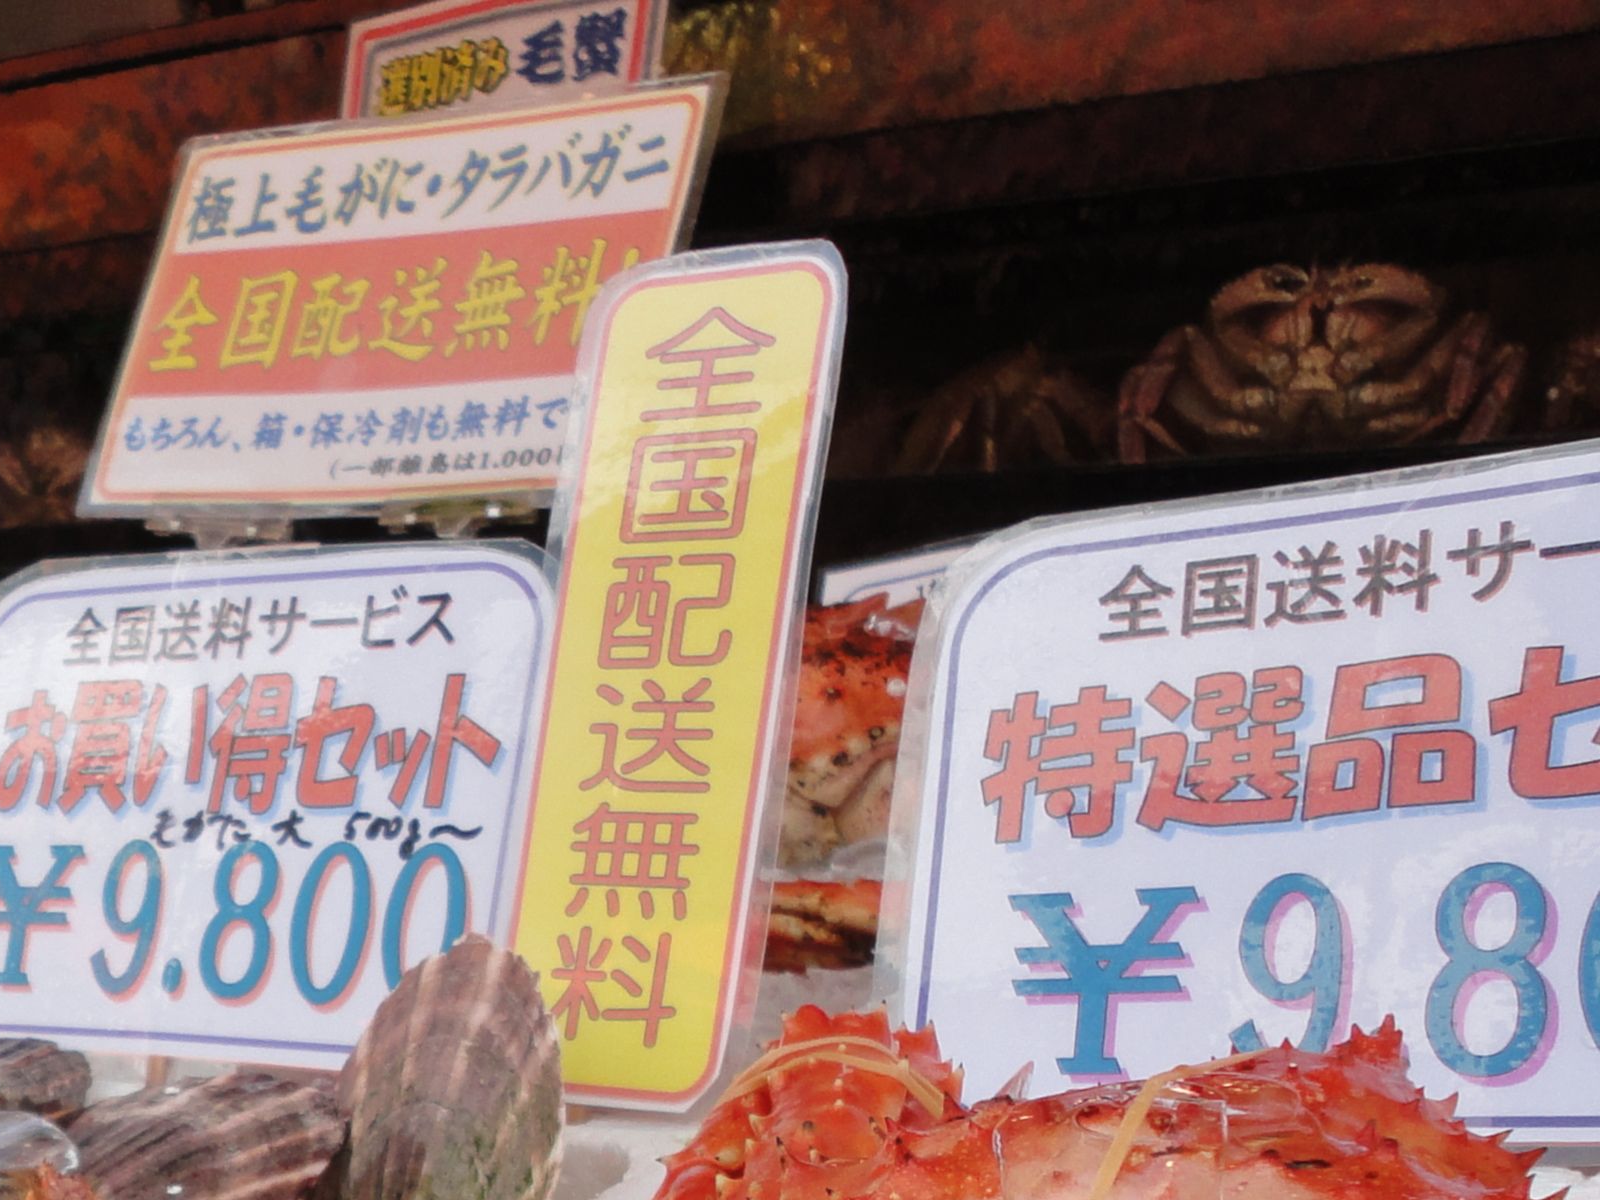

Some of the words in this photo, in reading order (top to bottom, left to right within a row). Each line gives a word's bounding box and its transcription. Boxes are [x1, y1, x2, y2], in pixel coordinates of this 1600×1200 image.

[186, 127, 670, 243] 極上毛がに・タラバガニ
[61, 590, 456, 667] 全国送料サービス
[550, 306, 776, 1048] 全国配送無料
